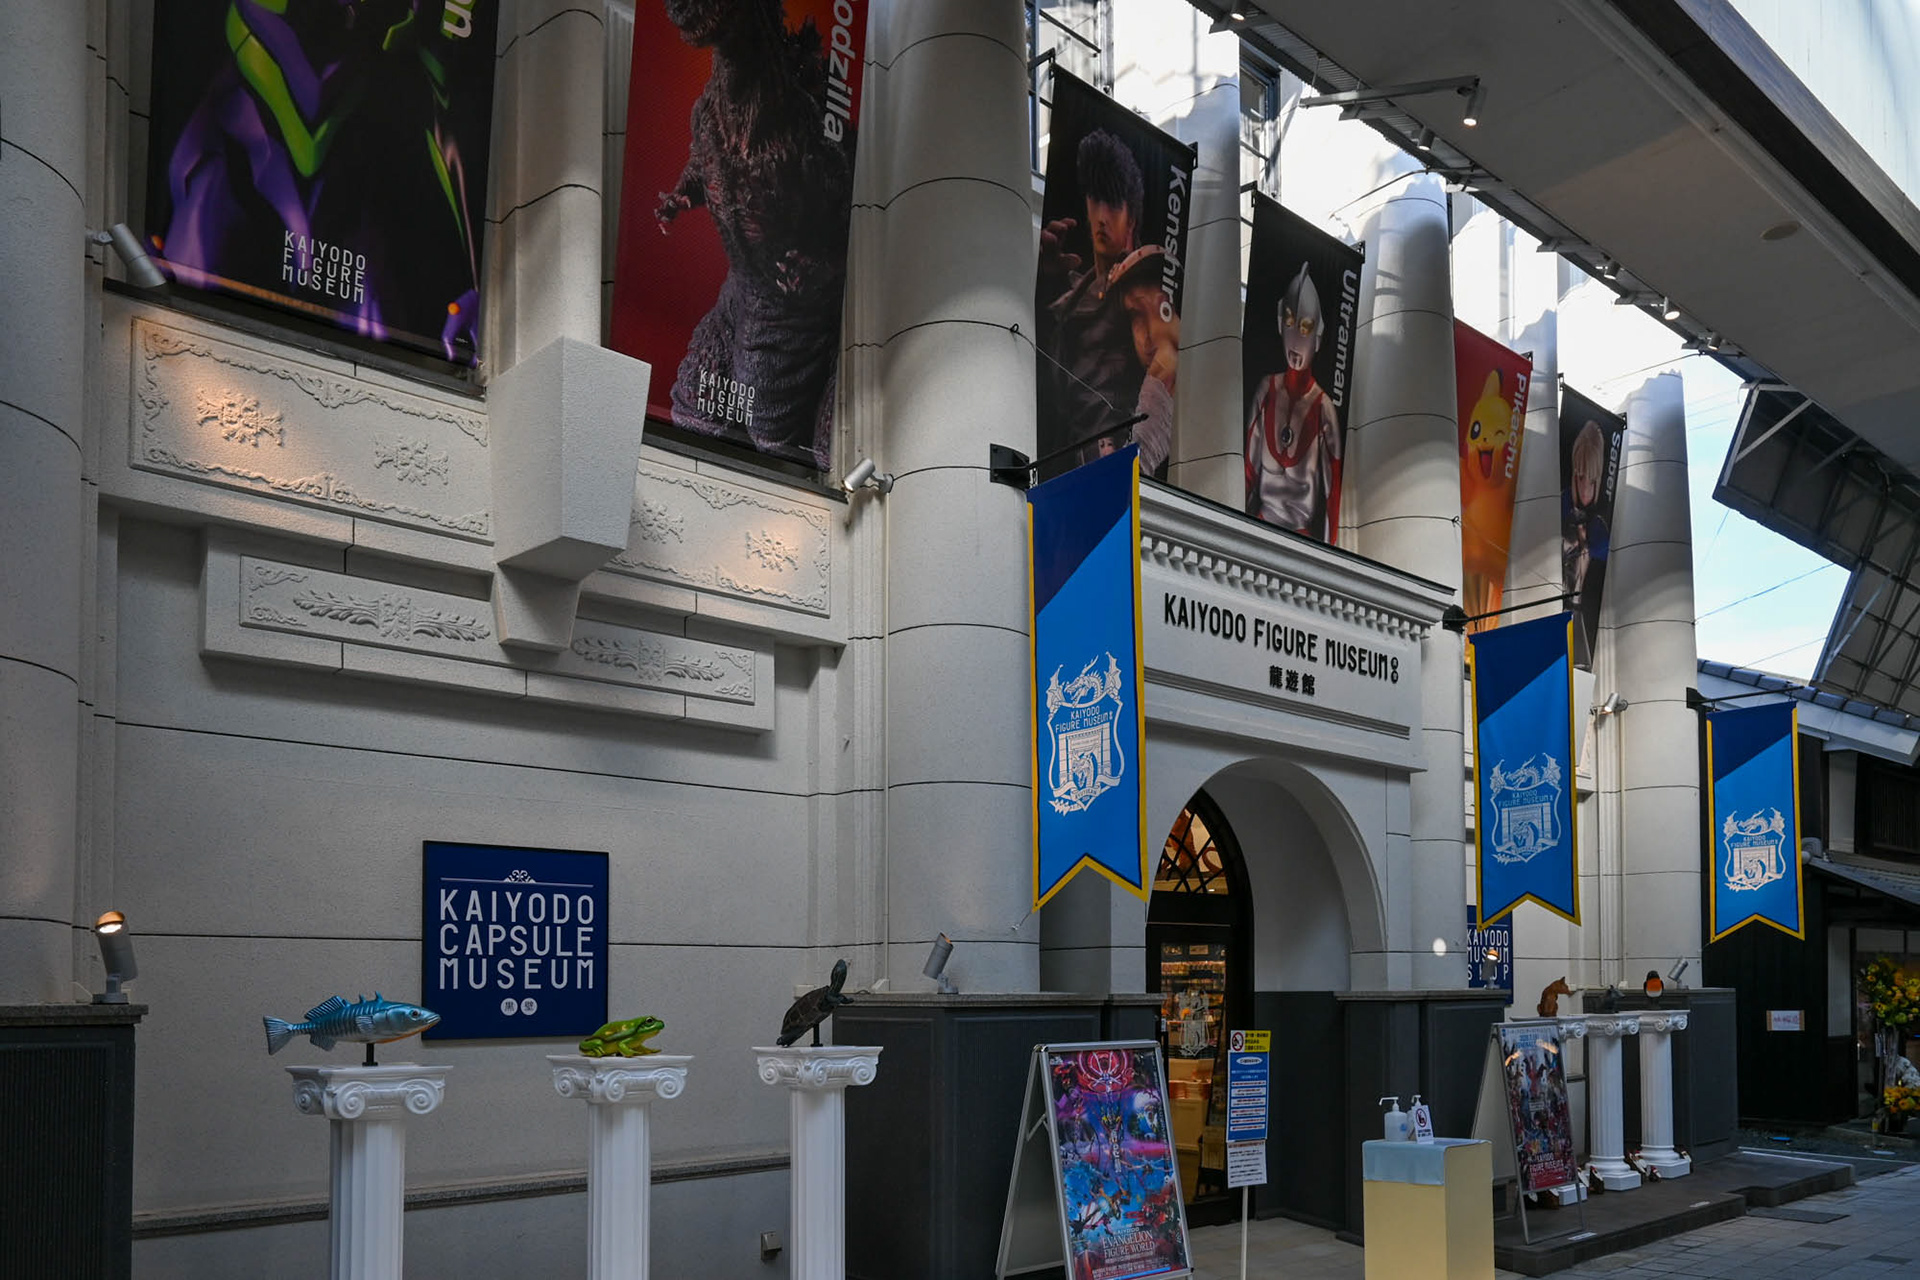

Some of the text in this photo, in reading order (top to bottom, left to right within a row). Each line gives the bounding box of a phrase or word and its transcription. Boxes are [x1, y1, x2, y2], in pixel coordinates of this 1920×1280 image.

[444, 0, 472, 38] n
[824, 0, 856, 142] odzilla
[285, 230, 366, 271] KAIYODO
[1160, 165, 1187, 323] Kenshiro
[282, 264, 364, 304] MUSEUM
[284, 247, 365, 288] FIGURE
[1332, 269, 1357, 407] Ultraman
[698, 384, 753, 413] FIGURE
[700, 369, 756, 399] KAIYODO
[697, 398, 753, 427] MUSEUM
[1505, 373, 1528, 479] Pikachu
[1607, 431, 1621, 502] Saber
[1164, 593, 1247, 642] KAIYODO
[1254, 618, 1319, 662] FIGURE
[1325, 638, 1388, 681] MUSEUM
[1055, 712, 1109, 733] FIGURE MUSEUM
[1070, 705, 1100, 721] KAIYODO
[440, 889, 594, 925] KAIYODO
[440, 923, 593, 956] CAPSULE
[1467, 929, 1509, 946] KAIYODO
[1467, 946, 1509, 963] MUSUM
[439, 958, 593, 990] MUSEUM
